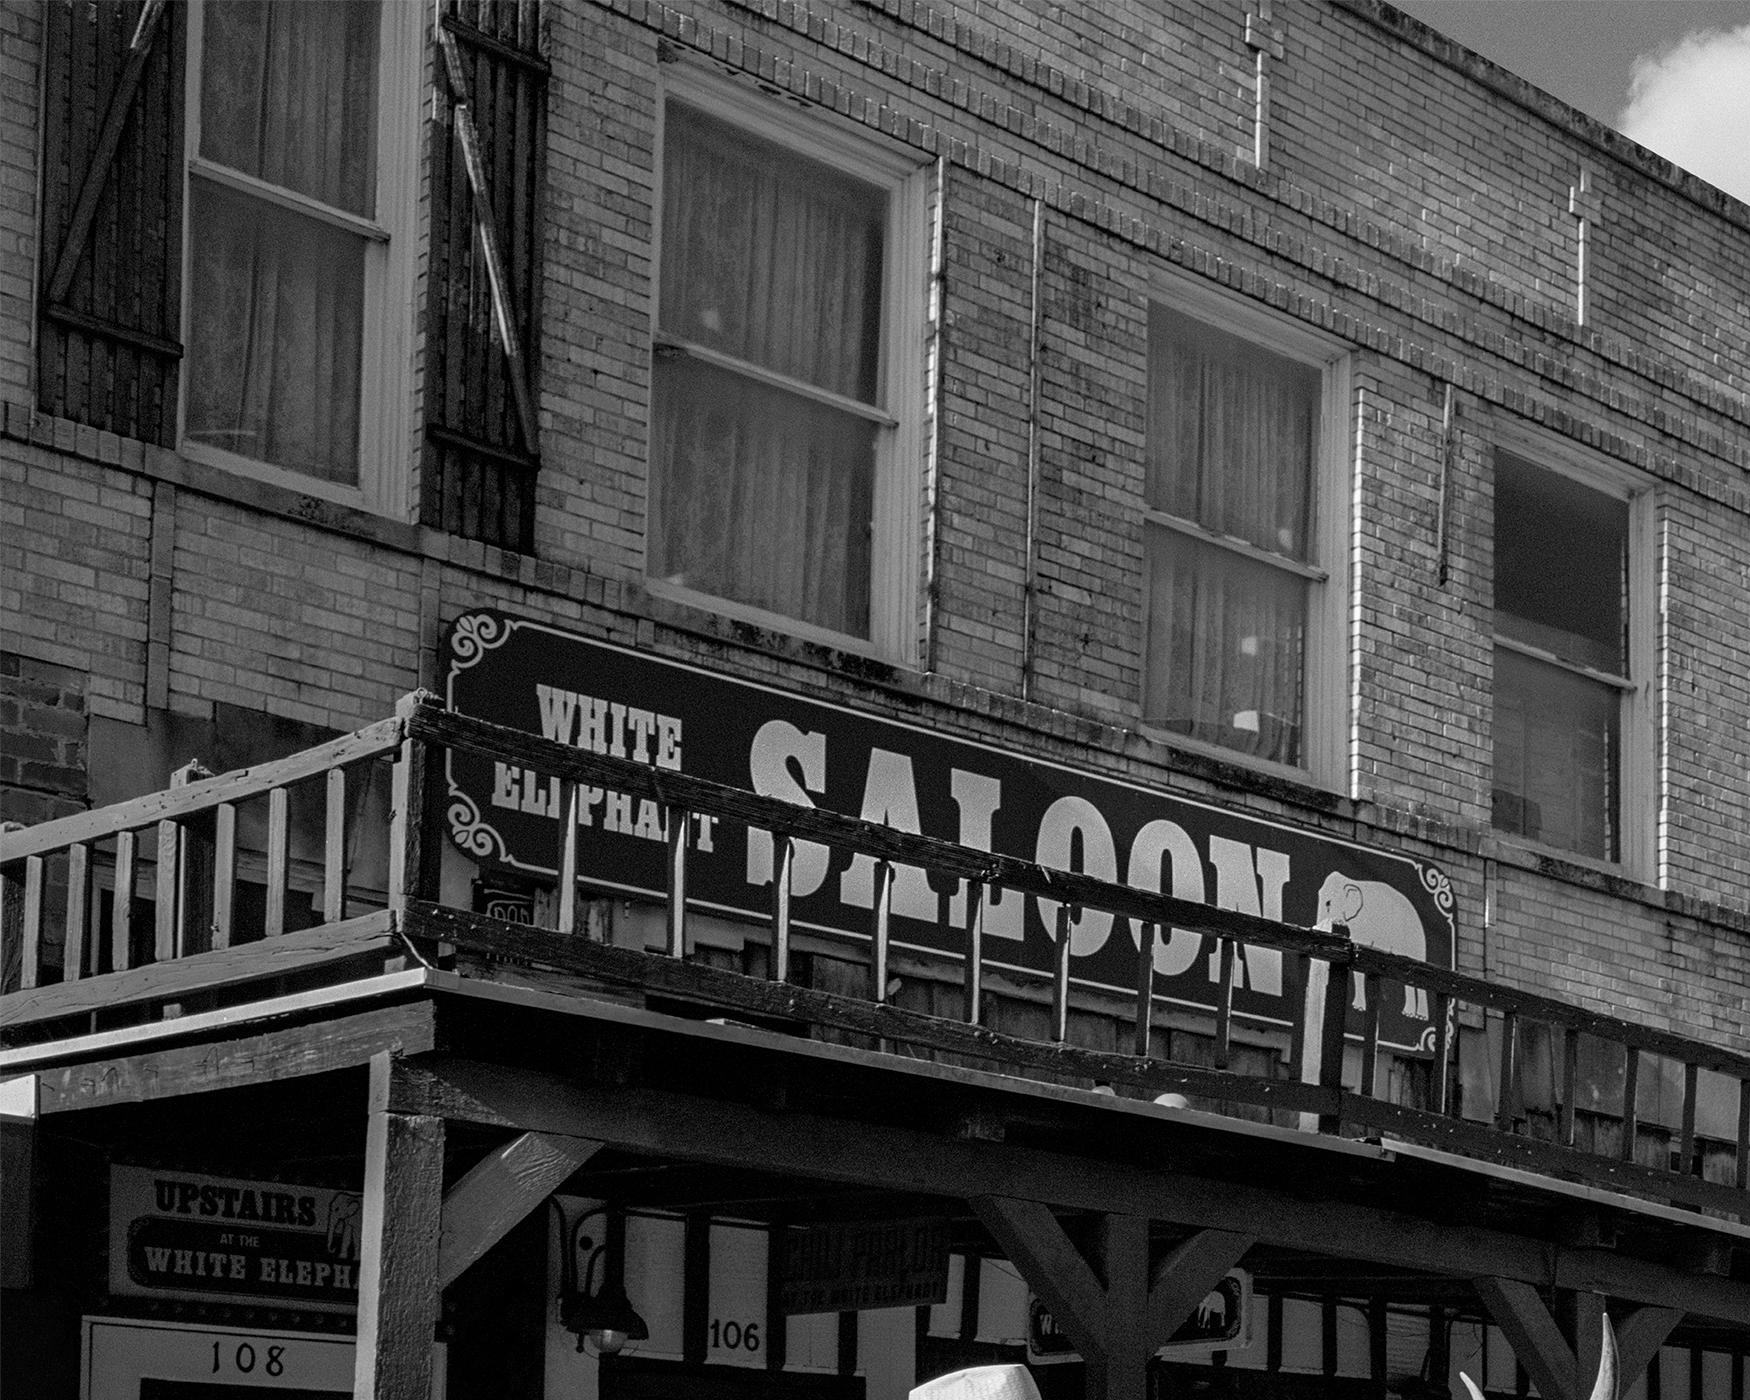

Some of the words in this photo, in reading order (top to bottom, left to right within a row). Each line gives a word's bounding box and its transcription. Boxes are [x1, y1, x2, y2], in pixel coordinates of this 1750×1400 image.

[536, 683, 682, 772] WHITE
[491, 761, 719, 853] ELPHAT
[747, 719, 1291, 997] SALOON
[153, 1179, 316, 1227] UPSTAIRS
[219, 1233, 234, 1246] AT
[238, 1234, 261, 1249] THE
[143, 1246, 247, 1280] WHITE
[259, 1256, 359, 1290] ELEPH
[709, 1319, 760, 1352] 106
[212, 1341, 286, 1377] 108
